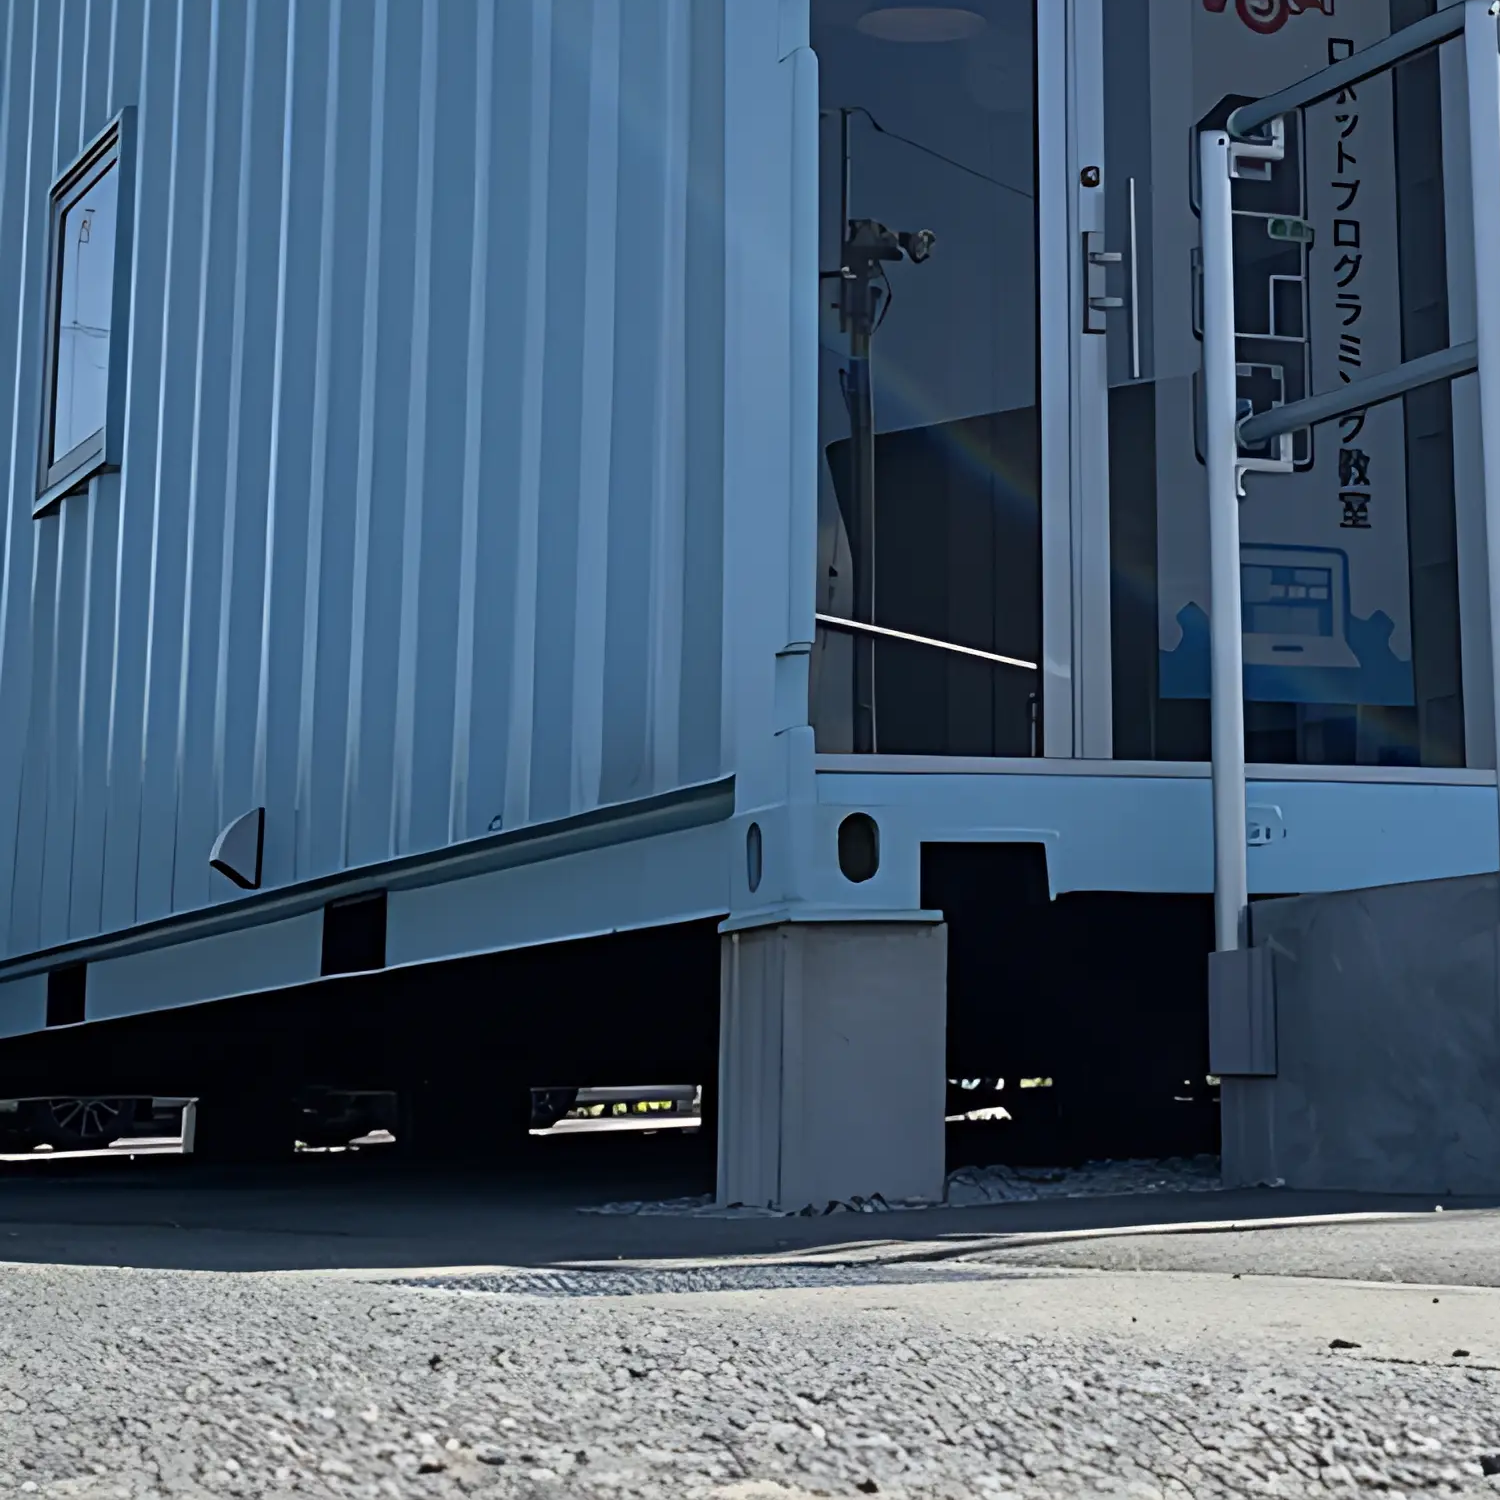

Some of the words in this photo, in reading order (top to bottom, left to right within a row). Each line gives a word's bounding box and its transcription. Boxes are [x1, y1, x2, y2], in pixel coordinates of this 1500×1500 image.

[1327, 37, 1372, 529] ロットプログラミグ教室
